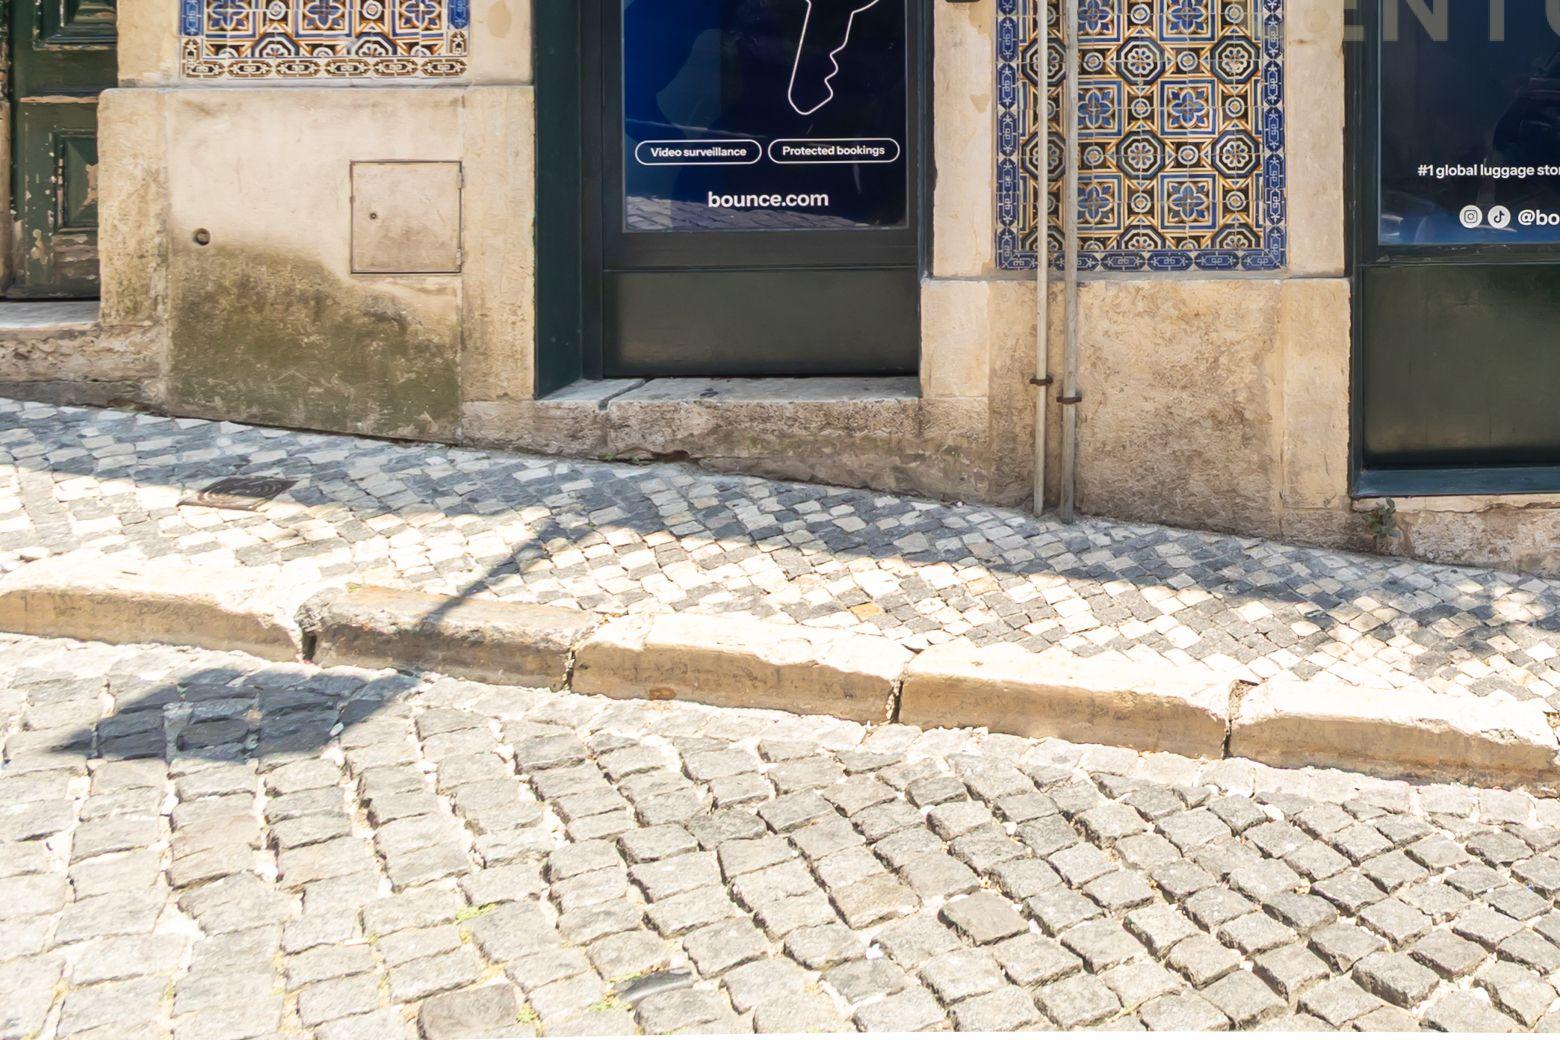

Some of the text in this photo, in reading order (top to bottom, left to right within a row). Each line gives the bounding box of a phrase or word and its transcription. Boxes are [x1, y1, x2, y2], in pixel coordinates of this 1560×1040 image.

[651, 147, 746, 157] Video surveillance
[783, 146, 885, 156] Protected bookings
[1418, 165, 1433, 176] #1
[1436, 164, 1477, 178] global
[1480, 164, 1534, 178] luggage
[708, 192, 828, 207] bounce.com
